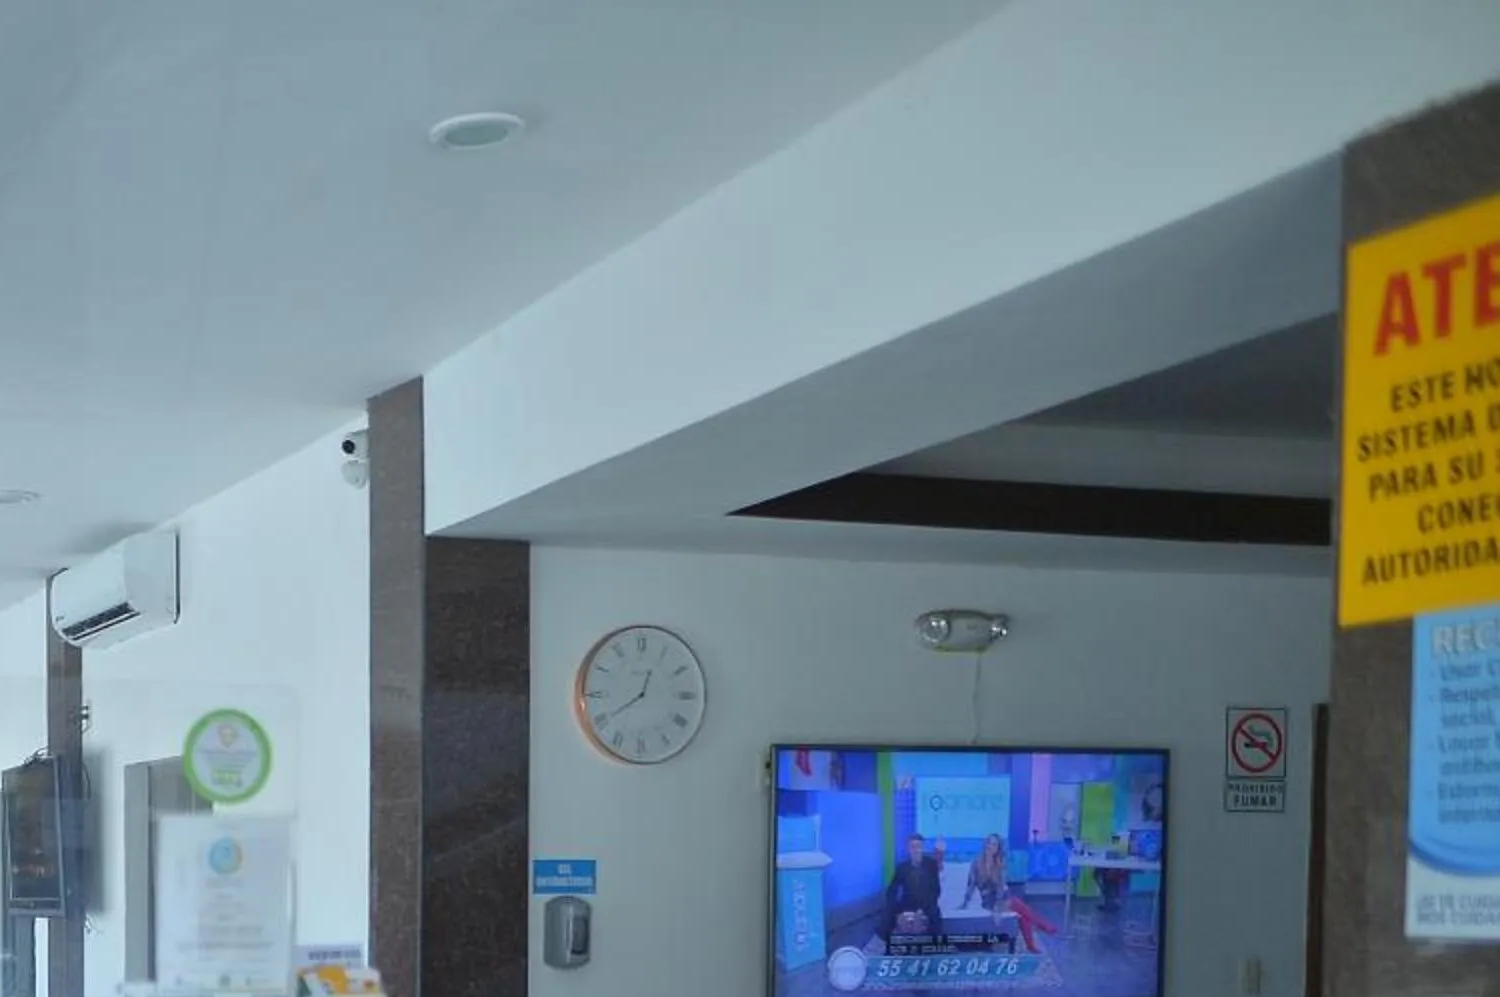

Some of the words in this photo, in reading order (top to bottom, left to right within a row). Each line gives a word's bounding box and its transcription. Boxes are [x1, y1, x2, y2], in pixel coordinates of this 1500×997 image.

[1390, 370, 1456, 413] ESTE
[1357, 409, 1476, 463] SISTEMA
[1368, 462, 1438, 503] PARA
[1448, 449, 1484, 486] SU
[1233, 794, 1278, 807] FUMAR
[877, 959, 901, 977] 55
[937, 959, 961, 976] 62
[996, 958, 1019, 976] 76
